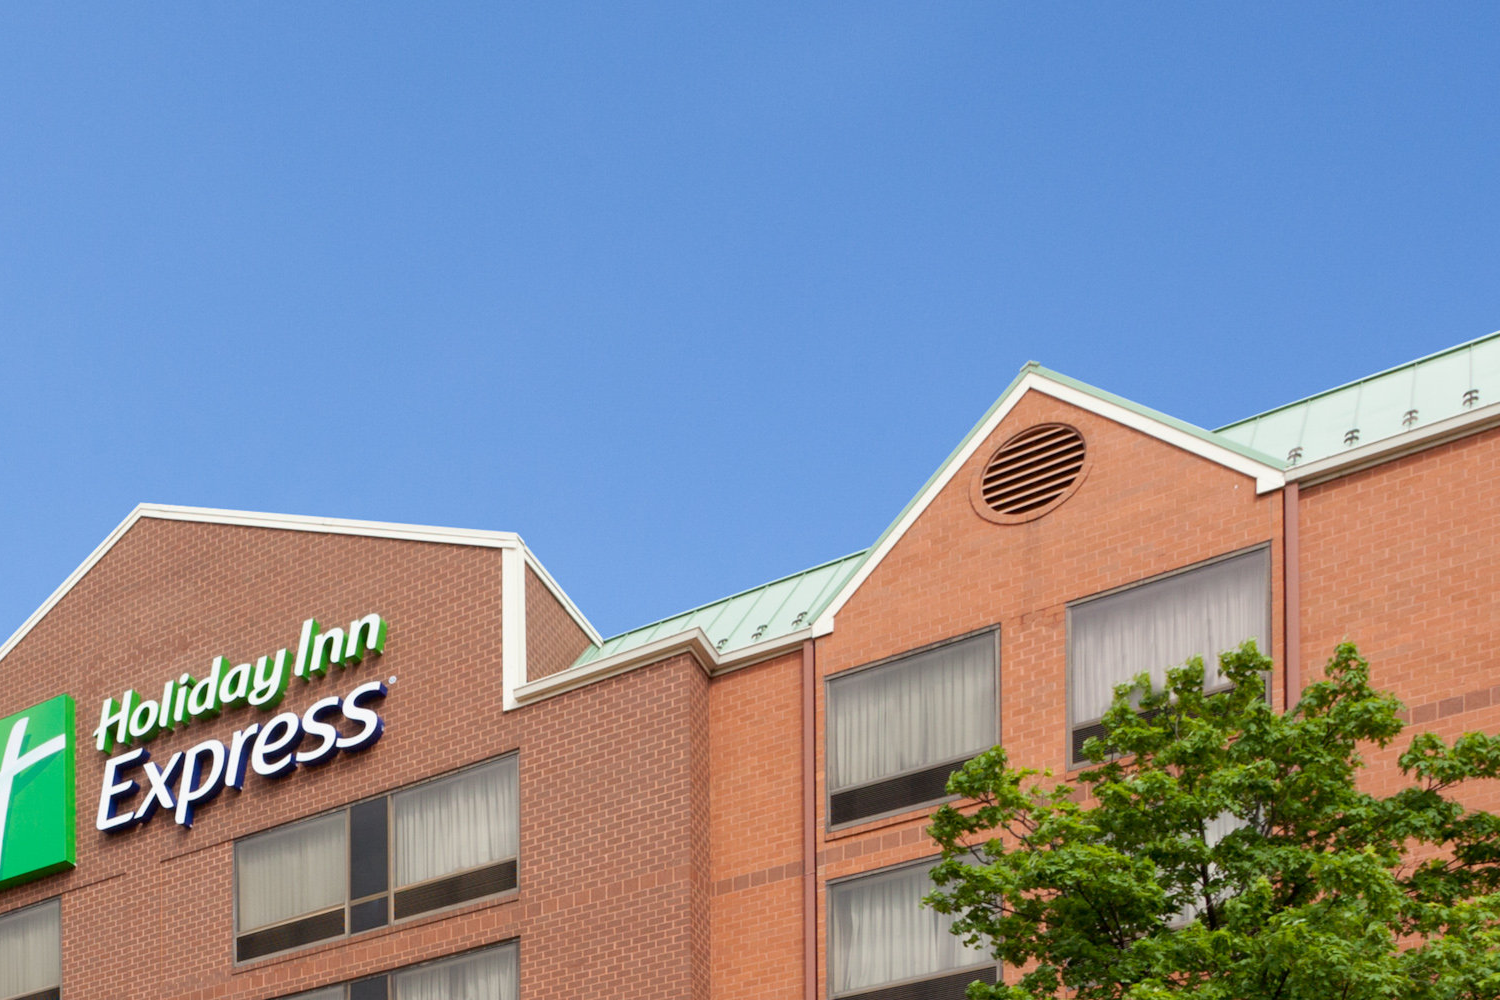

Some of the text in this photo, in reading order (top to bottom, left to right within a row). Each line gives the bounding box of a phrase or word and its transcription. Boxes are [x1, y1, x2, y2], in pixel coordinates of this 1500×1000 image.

[94, 613, 387, 753] Holiday Inn
[96, 681, 388, 832] Express
